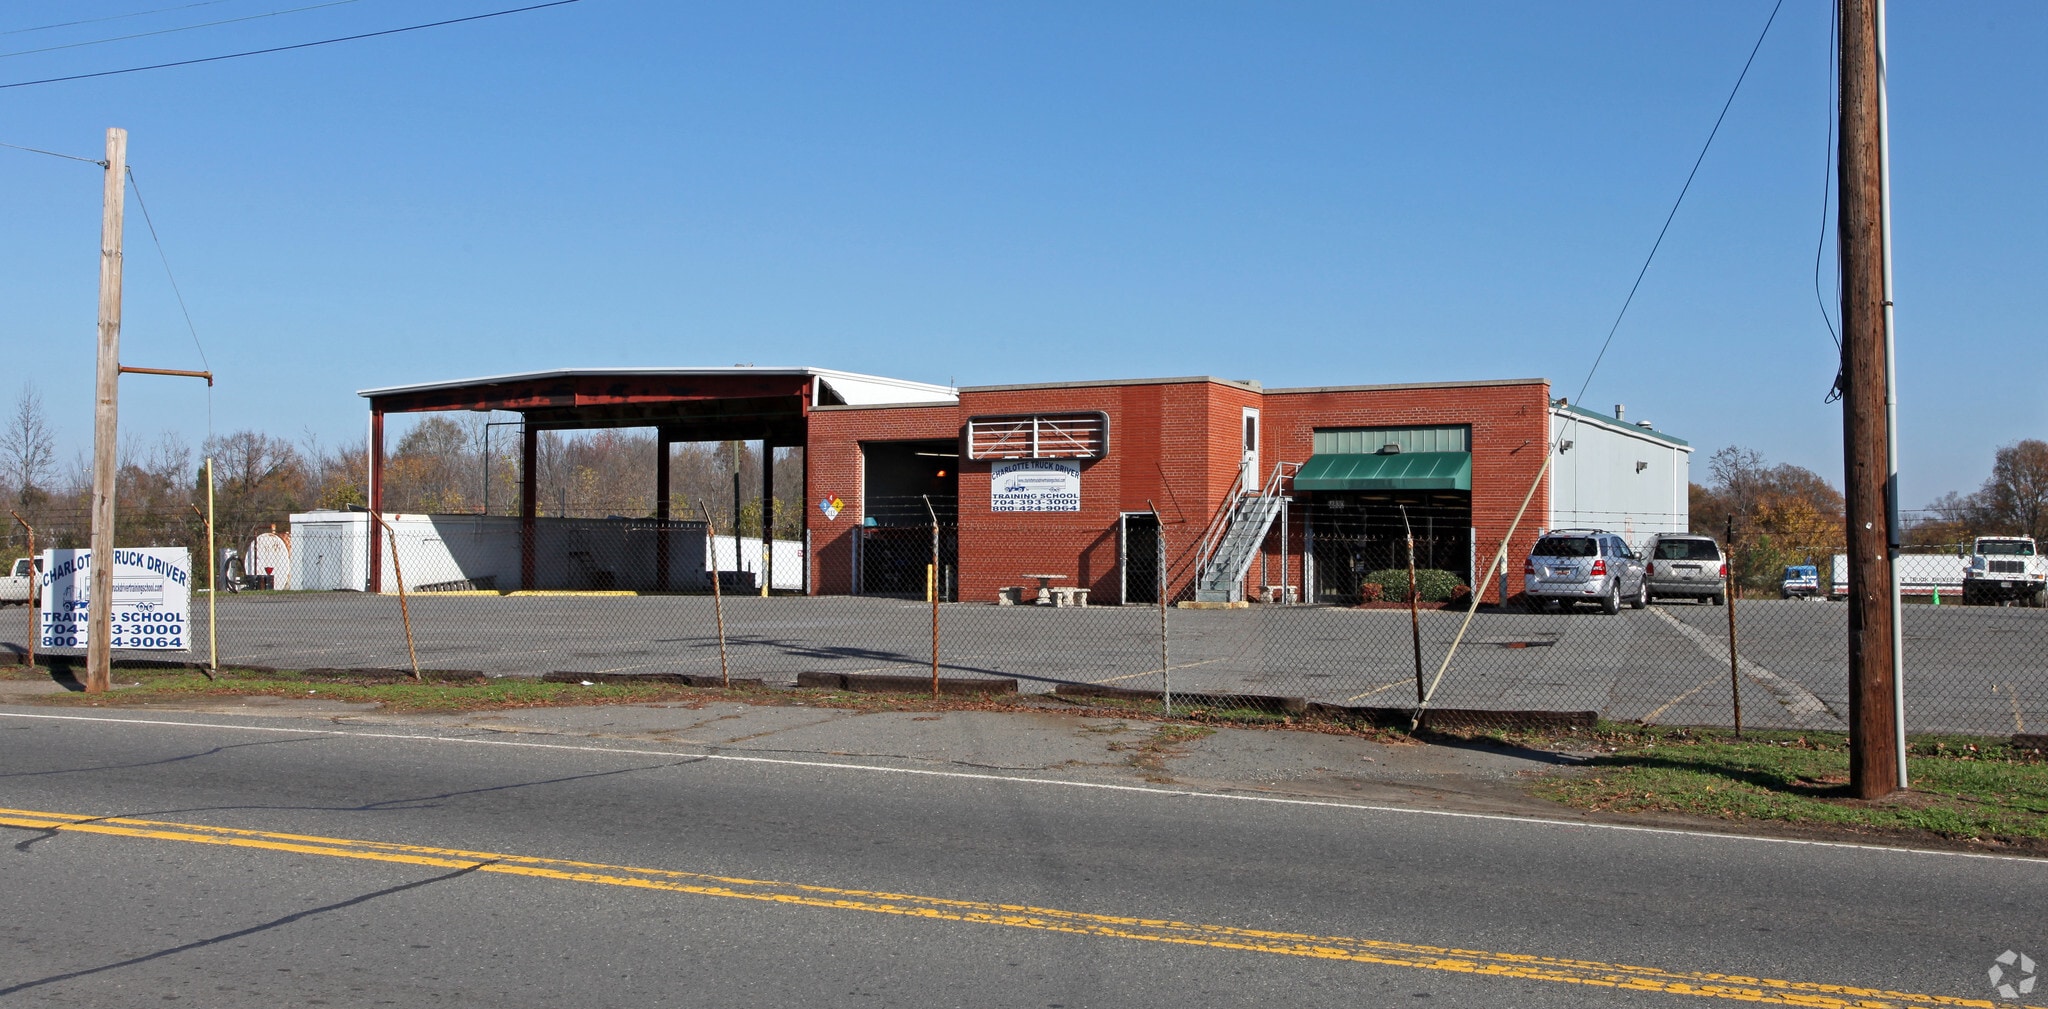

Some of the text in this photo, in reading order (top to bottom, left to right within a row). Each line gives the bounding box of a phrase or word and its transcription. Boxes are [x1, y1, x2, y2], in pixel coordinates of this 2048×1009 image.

[992, 461, 1079, 480] CHARLOTTE TRUCK DRIVER
[43, 550, 187, 587] CHARLOT RUCK DRIVER
[42, 612, 185, 622] TRAIN SCHOOL
[43, 624, 182, 635] 704-3-3000
[42, 636, 183, 647] 800-4-9064
